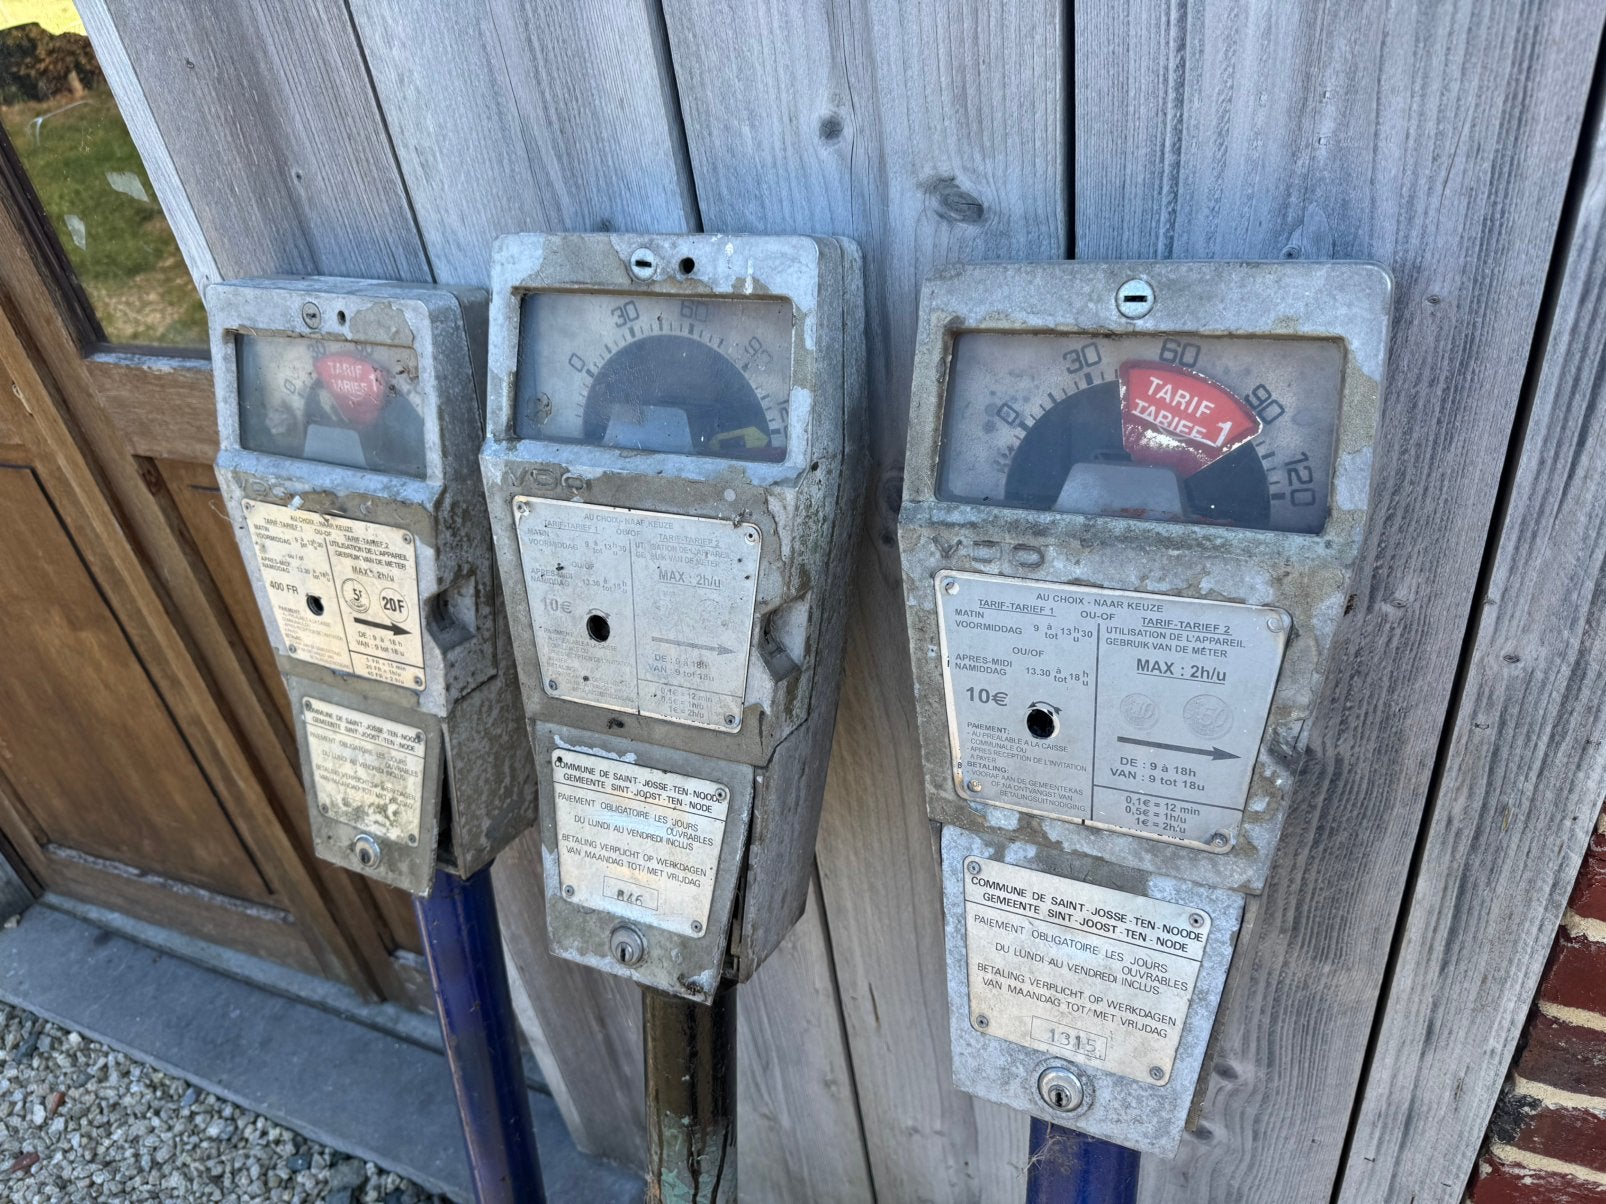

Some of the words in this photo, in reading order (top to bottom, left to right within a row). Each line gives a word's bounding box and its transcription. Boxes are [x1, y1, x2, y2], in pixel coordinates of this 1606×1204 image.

[611, 300, 640, 328] 30
[680, 301, 708, 323] 60
[568, 352, 585, 373] 0
[1063, 342, 1101, 374] 30
[1160, 338, 1200, 369] 60
[328, 362, 363, 376] TARIF
[996, 403, 1019, 426] 0
[1247, 384, 1285, 425] 90
[1148, 377, 1215, 418] TARIF
[1132, 399, 1206, 439] TARIEF
[1216, 422, 1233, 447] 1
[1285, 451, 1315, 507] 120
[658, 567, 684, 583] MAX
[695, 573, 721, 588] 2h/u
[285, 583, 299, 595] FR
[541, 596, 573, 614] 10€
[977, 598, 1045, 614] TARIF-TARIEF
[1049, 607, 1054, 615] 1
[1036, 592, 1049, 601] AU
[1052, 594, 1084, 605] CHOIX
[1093, 597, 1124, 609] NAAR
[1127, 601, 1164, 613] KEUZE
[954, 608, 984, 619] MATIN
[1080, 609, 1115, 622] OU-OF
[955, 619, 1022, 635] VOORMIDDAG
[1033, 624, 1039, 632] 9
[1044, 631, 1058, 640] tot
[1060, 627, 1071, 636] 13
[1081, 629, 1092, 638] 30
[1140, 616, 1220, 634] TARIF-TARIEF
[1222, 625, 1231, 634] 2
[1105, 636, 1150, 649] GEBRUIK
[1151, 641, 1172, 652] VAN
[1174, 644, 1189, 653] DE
[1106, 624, 1166, 640] UTILISATION
[1168, 632, 1183, 641] DE
[1185, 633, 1247, 648] L'APPAREIL
[955, 652, 1012, 668] APRES-MIDI
[1012, 646, 1045, 658] OU/OF
[954, 662, 1006, 676] NAMIDDAG
[1026, 666, 1050, 677] 13.30
[1053, 674, 1067, 683] tot
[1069, 672, 1080, 681] 18
[1135, 657, 1175, 675] MAX
[1189, 663, 1228, 682] 2h/u
[965, 685, 1008, 707] 10€
[967, 721, 1009, 734] PAIEMENT:
[970, 737, 1014, 751] COMMUNALE
[1015, 745, 1026, 753] OU
[970, 746, 992, 755] APRES
[1041, 742, 1068, 752] CAISSE
[554, 758, 595, 776] COMMUNE
[599, 769, 609, 779] DE
[966, 760, 1008, 773] BETALING:
[976, 754, 996, 763] PAYER
[1119, 756, 1138, 767] DE
[1149, 761, 1157, 770] 9
[1173, 765, 1197, 777] 18h
[563, 771, 605, 789] GEMEENTE
[972, 769, 999, 779] VOORAF
[1000, 774, 1015, 783] AAN
[1028, 779, 1083, 795] GEMEENTEKAS
[1109, 767, 1136, 780] VAN
[1148, 774, 1155, 783] 9
[1159, 776, 1178, 787] tot
[1180, 779, 1205, 791] 18u
[1002, 782, 1012, 790] NA
[1013, 784, 1056, 798] ONTVANGST
[1057, 793, 1072, 801] VAN
[557, 791, 595, 808] PAIEMENT
[600, 800, 649, 820] OBLIGATOIRE
[654, 813, 668, 824] LES
[671, 817, 699, 832] JOURS
[1163, 802, 1176, 811] 12
[1179, 804, 1201, 816] min
[1163, 812, 1187, 824] 1h/u
[1134, 817, 1149, 826] 1€
[574, 814, 585, 824] DU
[587, 817, 610, 830] LUNDI
[613, 823, 624, 833] AU
[627, 827, 663, 843] VENDREDI
[665, 836, 694, 851] INCLUS
[665, 827, 714, 846] OUVRABLES
[561, 832, 597, 849] BETALING
[599, 842, 640, 859] VERPLICHT
[642, 853, 653, 863] OP
[655, 856, 707, 877] WERKDAGEN
[565, 845, 581, 856] VAN
[584, 849, 623, 867] MAANDAG
[666, 871, 701, 888] VRIJDAG
[970, 875, 1026, 898] COMMUNE
[1032, 891, 1046, 903] DE
[982, 891, 1040, 914] GEMEENTE
[974, 913, 1025, 936] PAIEMENT
[1031, 928, 1099, 955] OBLIGATOIRE
[1104, 948, 1124, 962] LES
[1129, 955, 1169, 974] JOURS
[995, 942, 1009, 954] DU
[1014, 946, 1045, 963] LUNDI
[1047, 956, 1063, 969] AU
[1066, 961, 1118, 984] VENDREDI
[1120, 977, 1160, 995] INCLUS
[1120, 965, 1190, 992] OUVRABLES
[977, 962, 1024, 982] BETALING
[1028, 976, 1084, 999] VERPLICHT
[1087, 993, 1103, 1006] OP
[1105, 998, 1178, 1026] WERKDAGEN
[982, 977, 1002, 990] VAN
[1007, 984, 1061, 1007] MAANDAG
[1118, 1016, 1169, 1038] VRIJDAG
